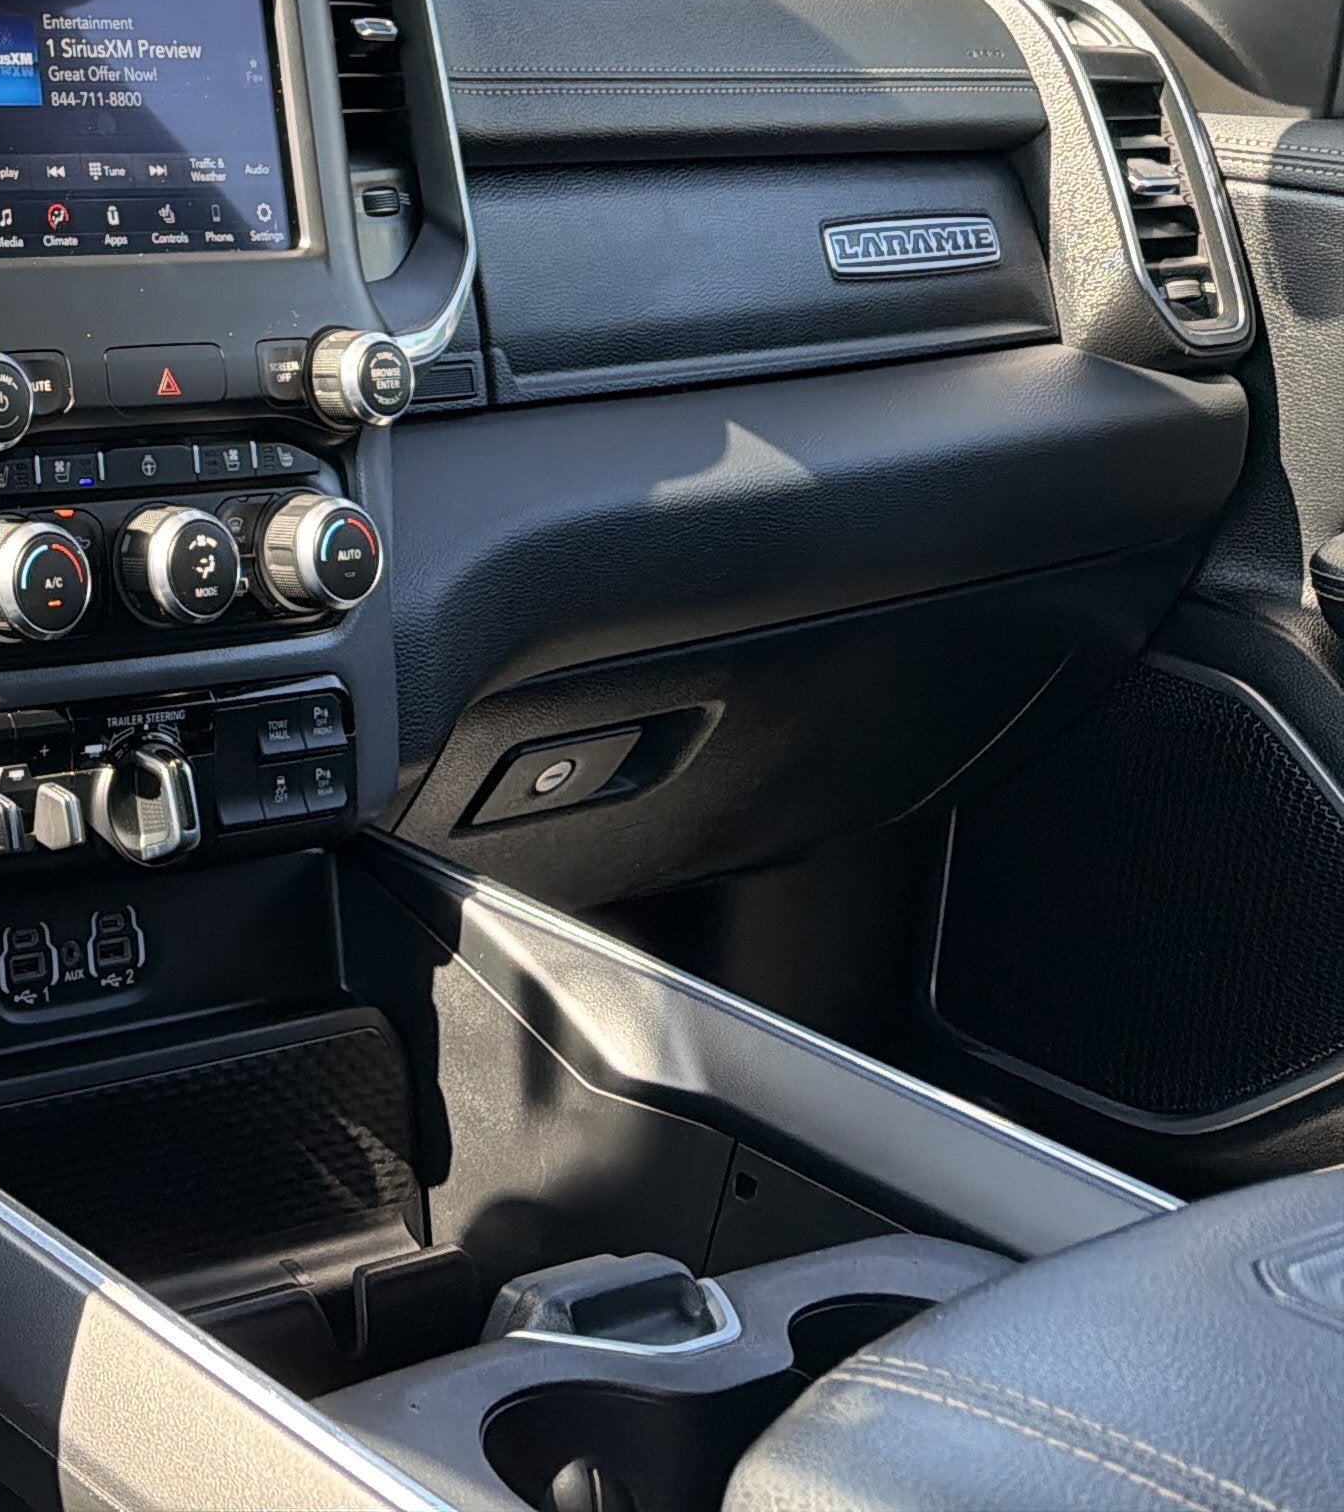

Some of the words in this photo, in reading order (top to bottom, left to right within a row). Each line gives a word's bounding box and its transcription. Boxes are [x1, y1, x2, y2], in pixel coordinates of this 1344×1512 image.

[42, 13, 134, 31] Entertainment
[46, 38, 55, 58] 1
[61, 37, 133, 59] SiriusXM
[137, 39, 202, 60] Preview
[47, 65, 86, 82] Great
[87, 65, 121, 82] Offer
[123, 66, 158, 82] Now!
[50, 91, 142, 108] 844-711-8800
[188, 157, 217, 170] Traffic
[244, 163, 270, 176] Audio
[103, 165, 127, 177] Tune
[190, 170, 227, 183] Weather
[42, 234, 79, 248] Climate
[104, 233, 129, 248] Apps
[151, 231, 190, 245] Controls
[204, 230, 235, 244] Phone
[249, 229, 284, 244] Settings
[832, 224, 996, 262] LARAMIE
[31, 379, 53, 393] UTE
[337, 548, 362, 562] AUTO
[44, 577, 64, 590] A/C
[194, 586, 220, 598] MODE
[106, 713, 144, 729] TRAILER
[144, 708, 186, 724] STEERING
[268, 729, 292, 741] HAUL
[64, 968, 86, 983] AUX
[125, 968, 135, 985] 2
[42, 986, 51, 1003] 1
